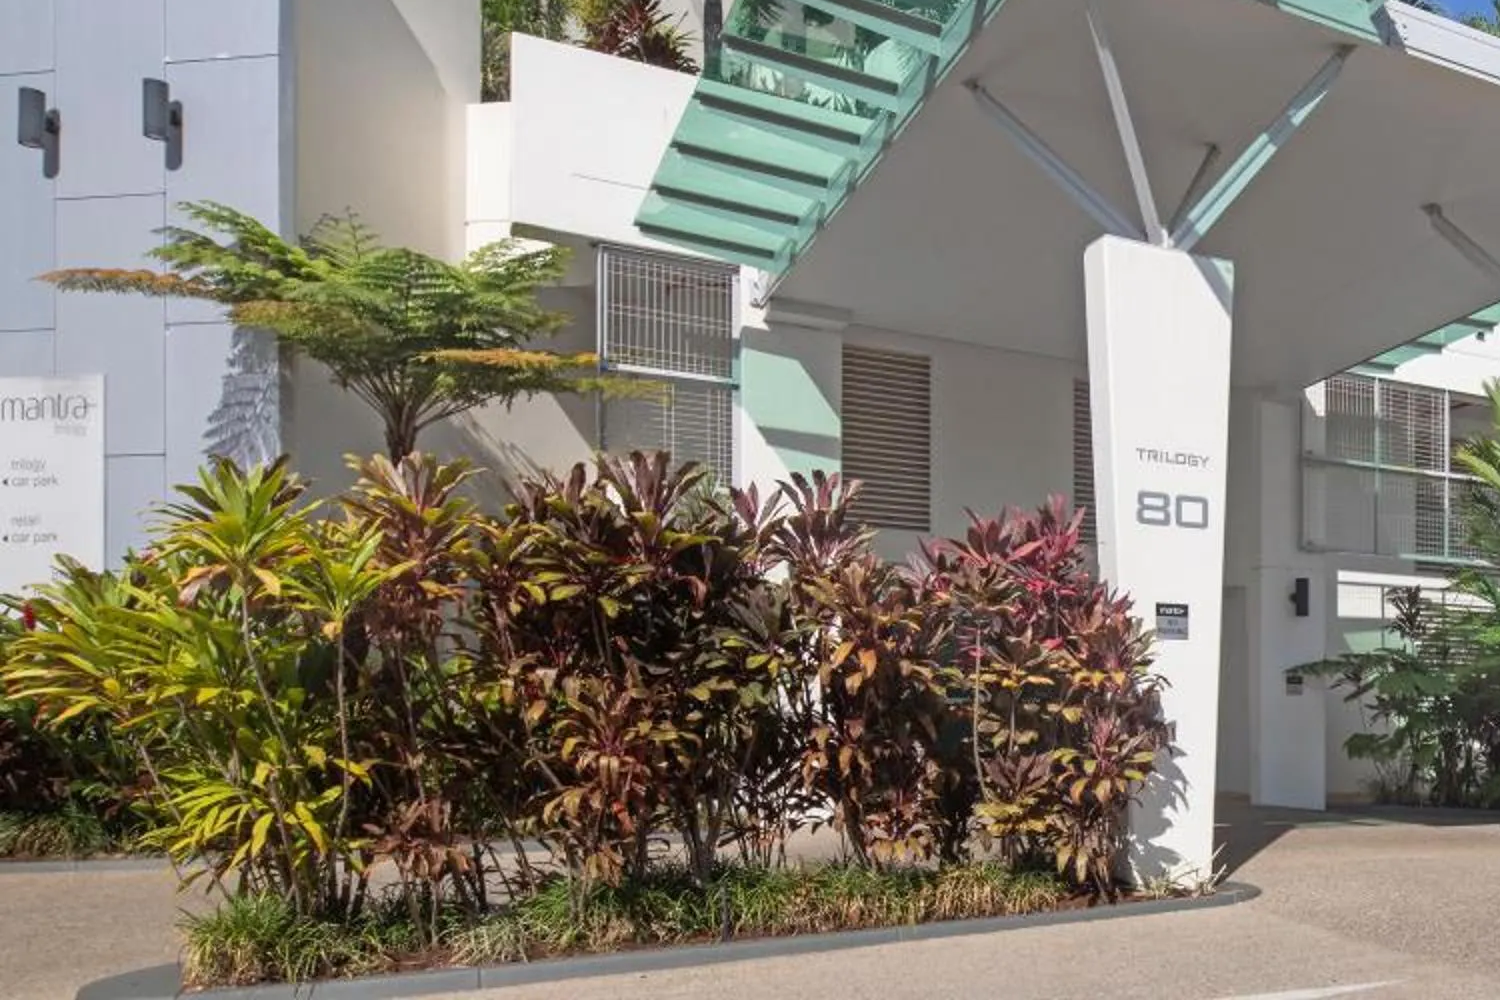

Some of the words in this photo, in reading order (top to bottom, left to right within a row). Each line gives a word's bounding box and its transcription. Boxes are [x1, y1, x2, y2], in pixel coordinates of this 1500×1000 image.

[1, 393, 97, 421] mantra
[11, 458, 46, 472] trilogy
[1136, 447, 1210, 467] TRILOGY
[11, 477, 29, 486] car
[33, 474, 58, 487] park
[1137, 490, 1209, 529] 80
[11, 533, 30, 543] car
[33, 531, 57, 544] park
